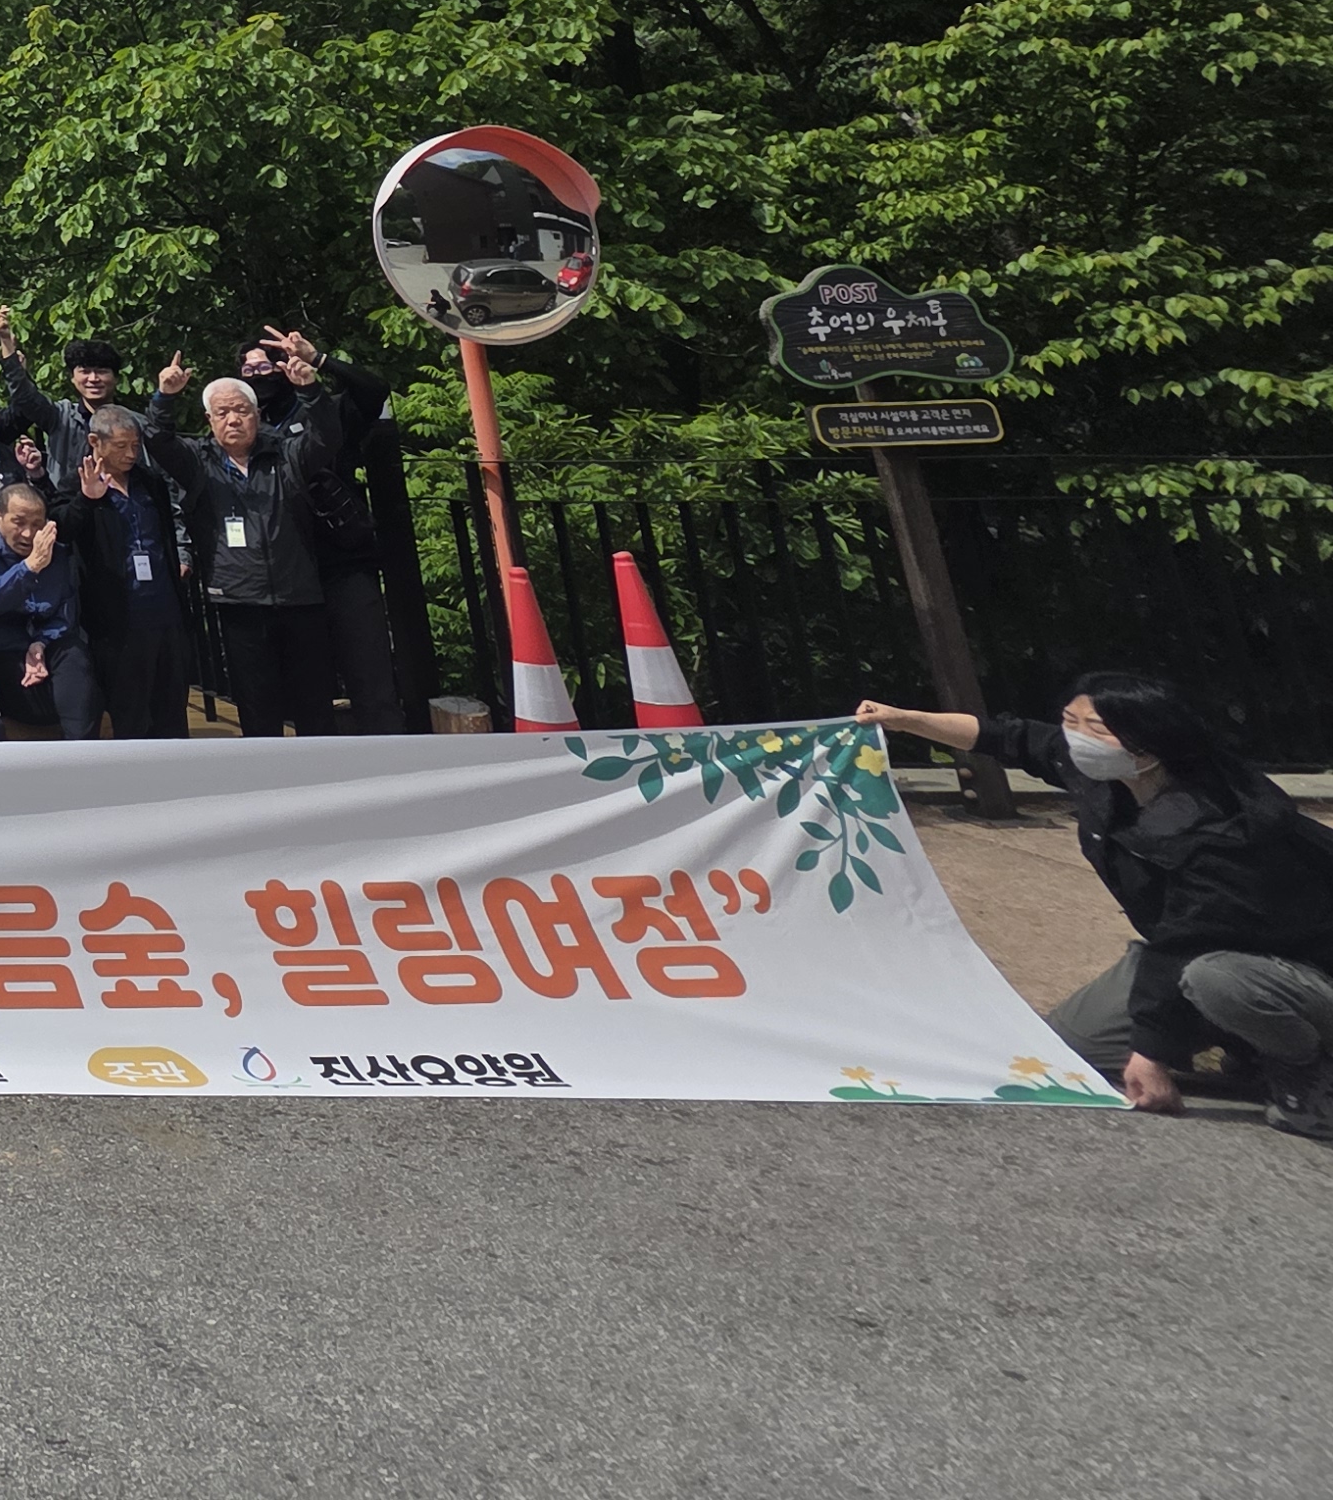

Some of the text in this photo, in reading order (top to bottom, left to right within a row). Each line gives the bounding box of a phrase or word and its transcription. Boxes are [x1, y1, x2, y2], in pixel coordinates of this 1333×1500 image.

[818, 282, 878, 305] POST
[807, 299, 948, 342] 추억의 우체통
[102, 1052, 572, 1088] 주관 진산요양원
